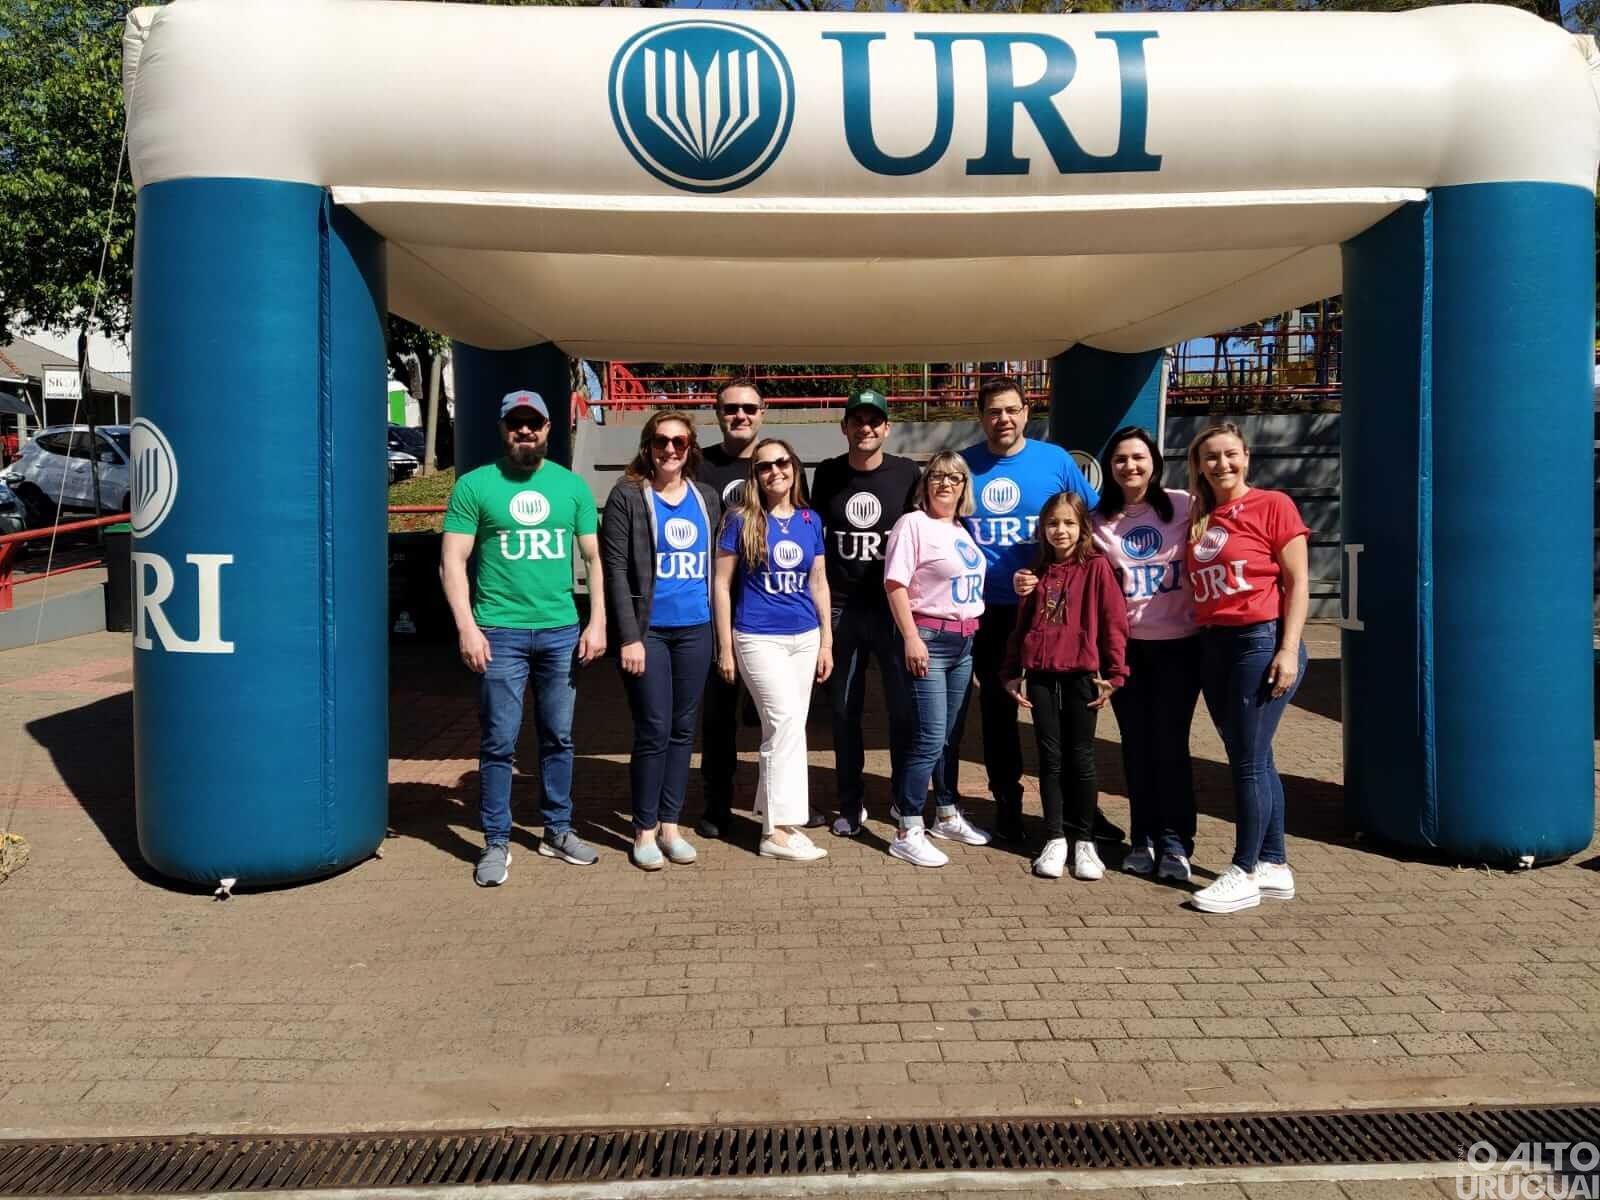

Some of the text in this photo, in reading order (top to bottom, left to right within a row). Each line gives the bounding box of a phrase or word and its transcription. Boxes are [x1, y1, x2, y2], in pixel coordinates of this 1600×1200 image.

[821, 30, 1162, 175] URI
[496, 528, 567, 560] URI
[968, 515, 1040, 546] URI
[656, 551, 707, 579] URI
[761, 571, 808, 594] URI
[949, 573, 983, 604] UR
[1190, 560, 1253, 602] URI
[131, 552, 234, 653] RI
